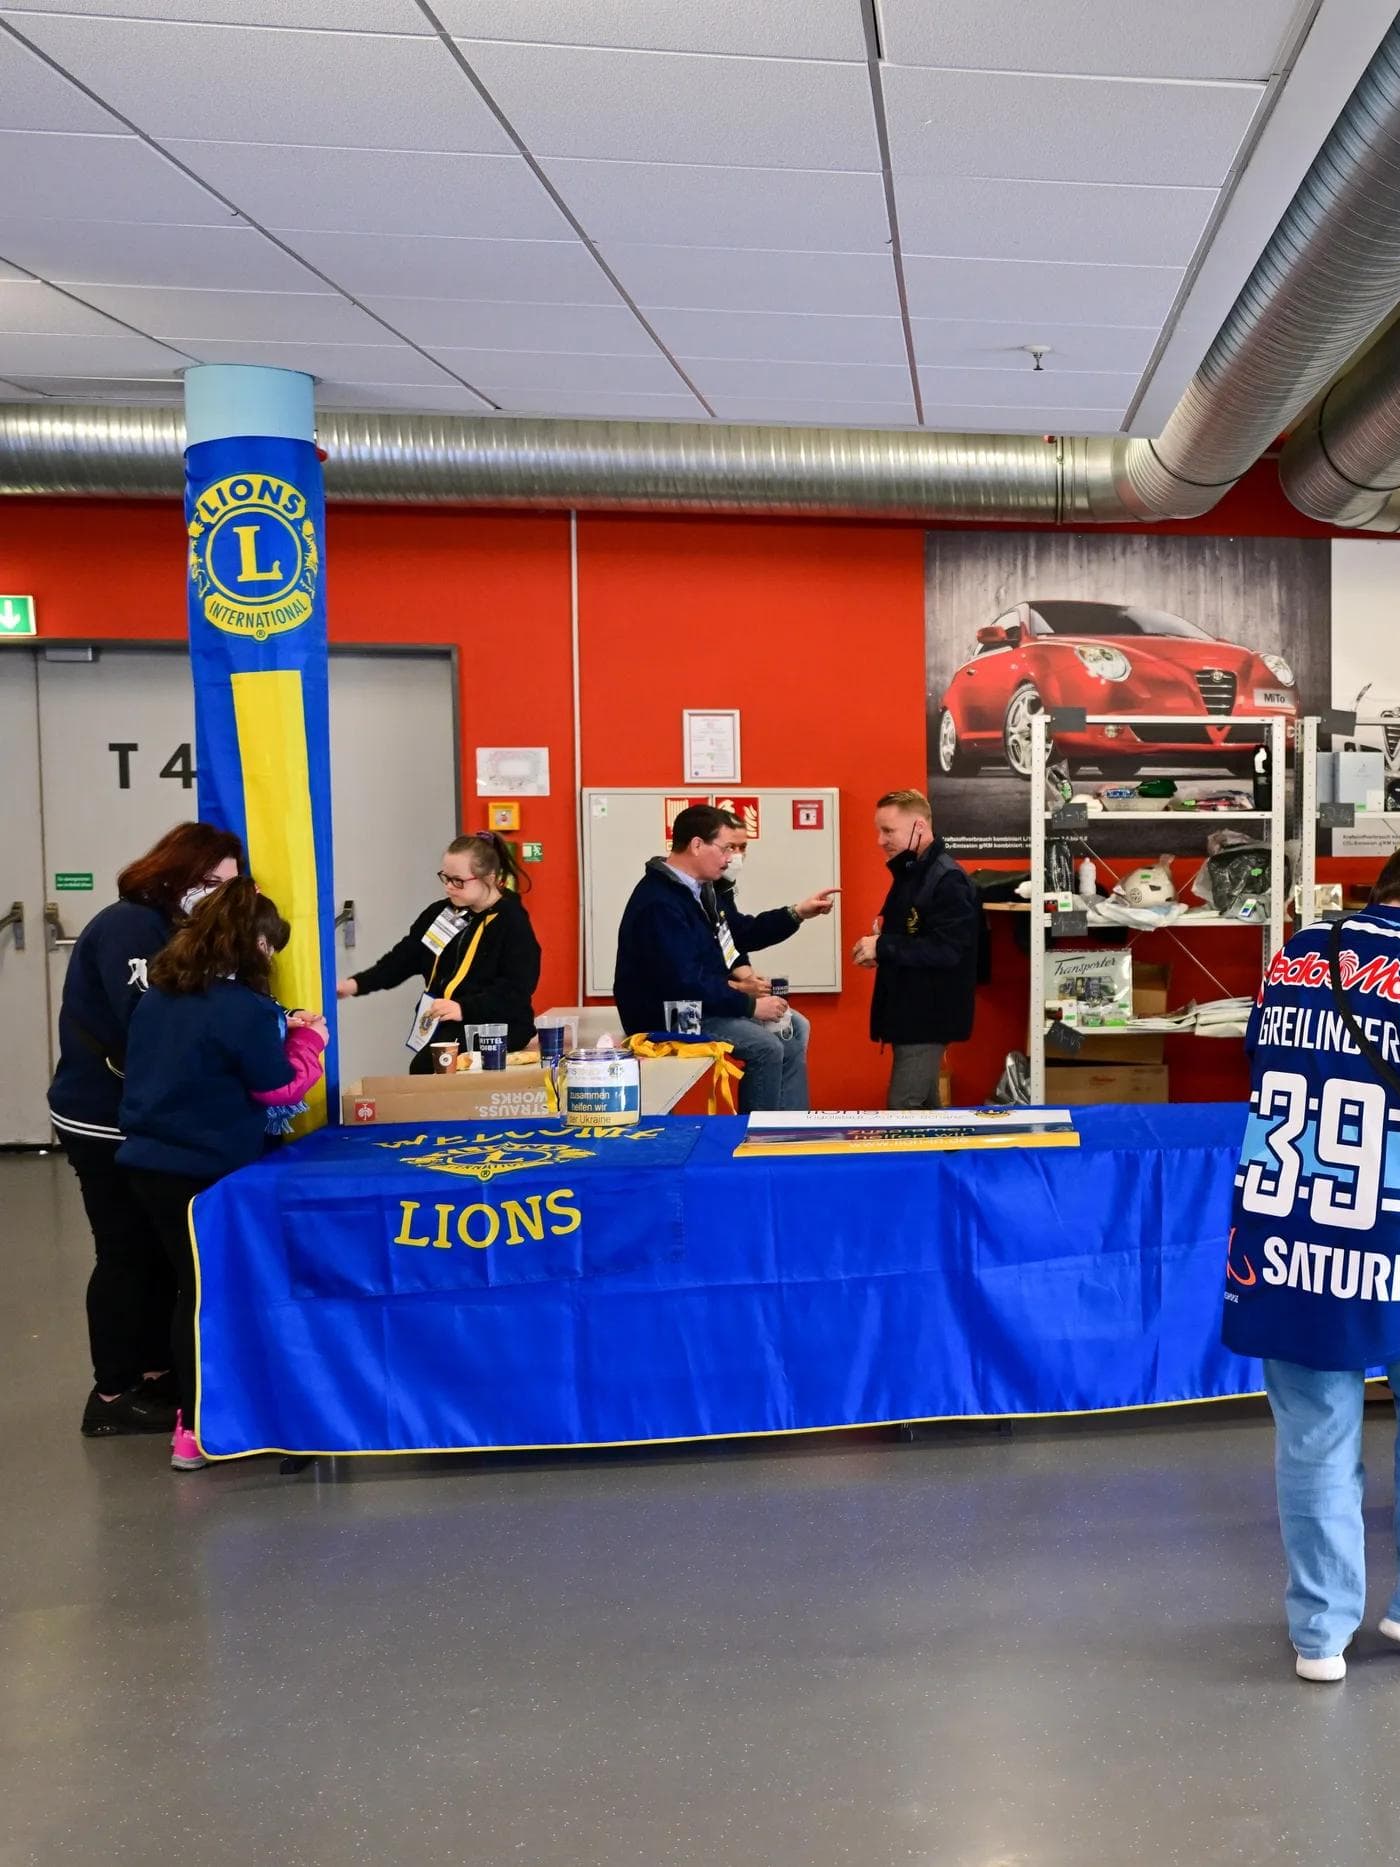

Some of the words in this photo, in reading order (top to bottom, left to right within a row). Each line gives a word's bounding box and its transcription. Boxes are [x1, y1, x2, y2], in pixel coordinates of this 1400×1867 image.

[200, 479, 302, 518] LIONS
[233, 525, 283, 582] L
[209, 599, 308, 629] INTERNATIONAL
[1263, 693, 1286, 704] MiTo
[109, 743, 139, 789] T
[159, 743, 198, 789] 4
[1055, 956, 1116, 976] Transporter
[1242, 1071, 1386, 1230] 39
[394, 1189, 582, 1248] LIONS
